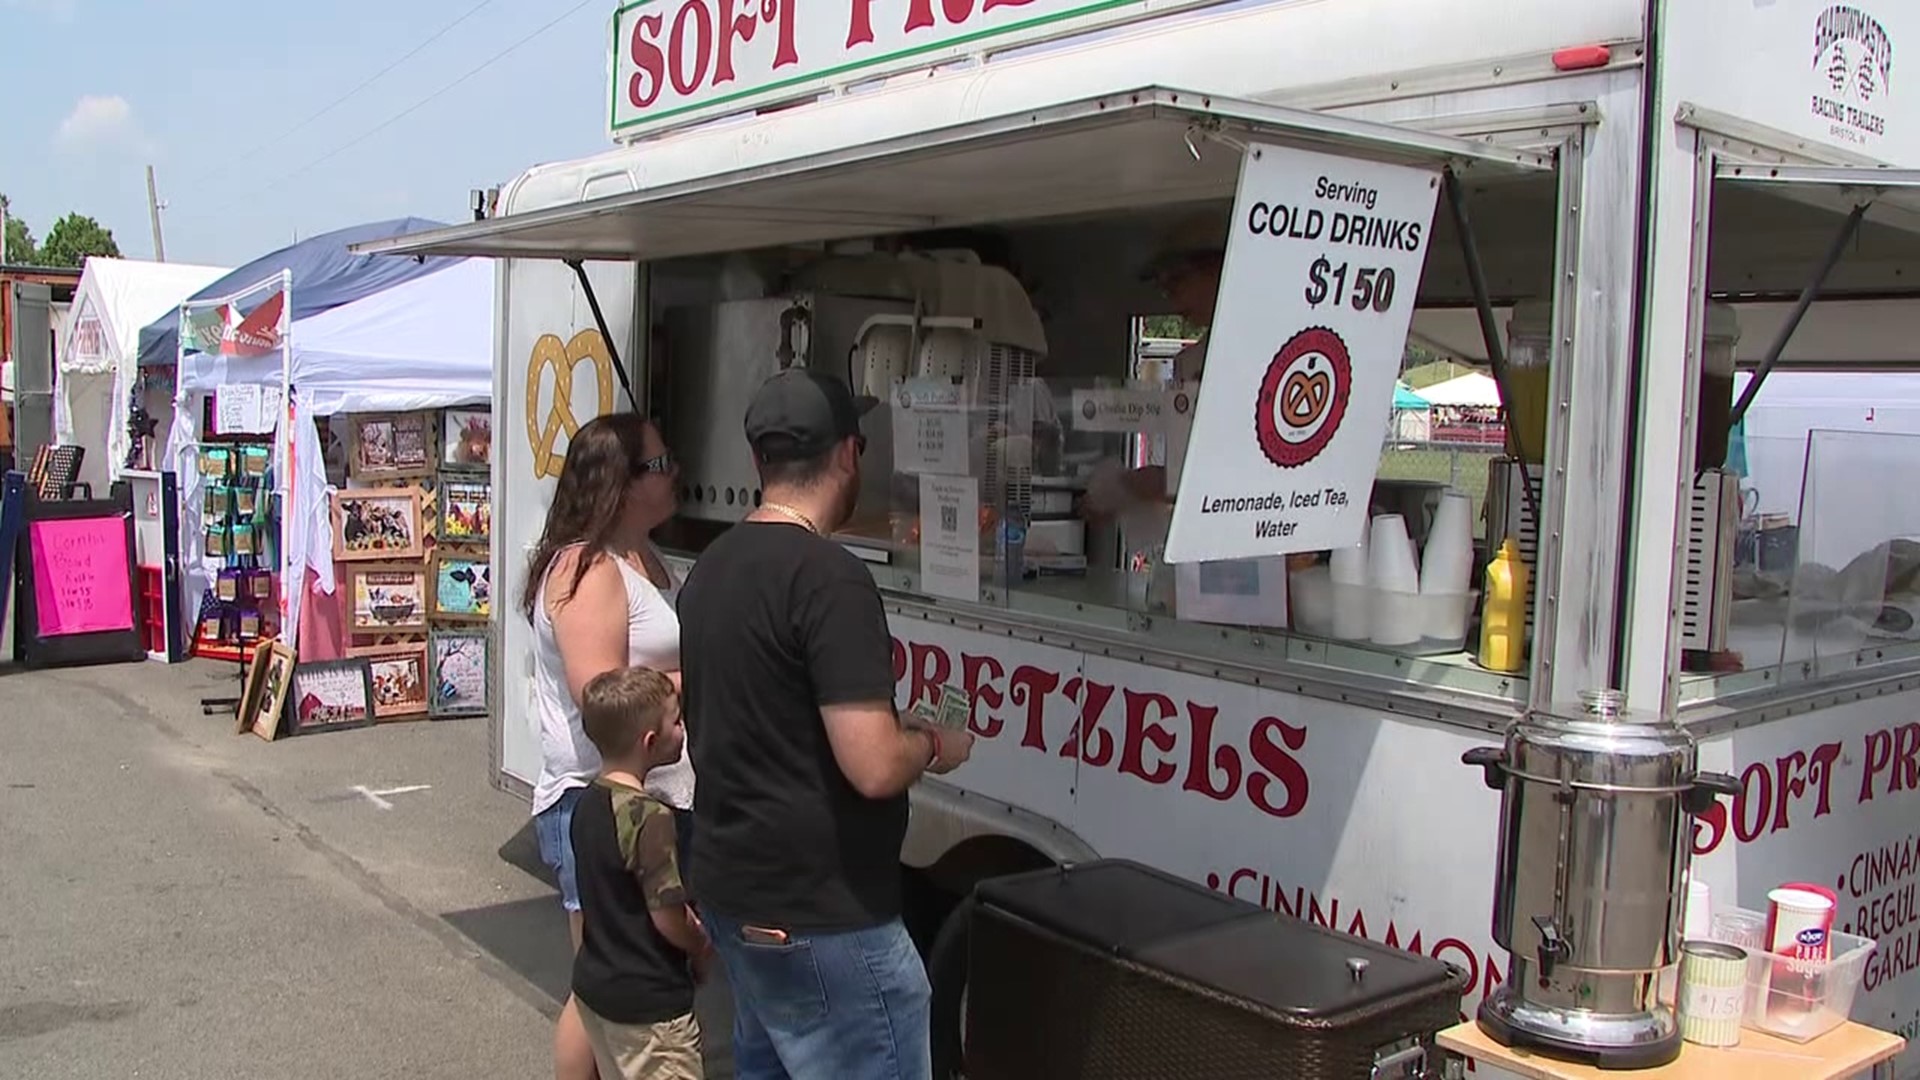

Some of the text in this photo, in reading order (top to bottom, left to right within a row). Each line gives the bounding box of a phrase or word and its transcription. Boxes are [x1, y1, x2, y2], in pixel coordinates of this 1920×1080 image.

[628, 0, 799, 108] SOFT
[1811, 95, 1885, 135] RACING TRAILERS
[1315, 176, 1378, 210] Serving
[1248, 202, 1422, 251] COLD DRINKS
[1201, 488, 1349, 514] Lemonade, Iced Tea,
[1255, 520, 1298, 538] Water
[1857, 883, 1920, 941] REGUL
